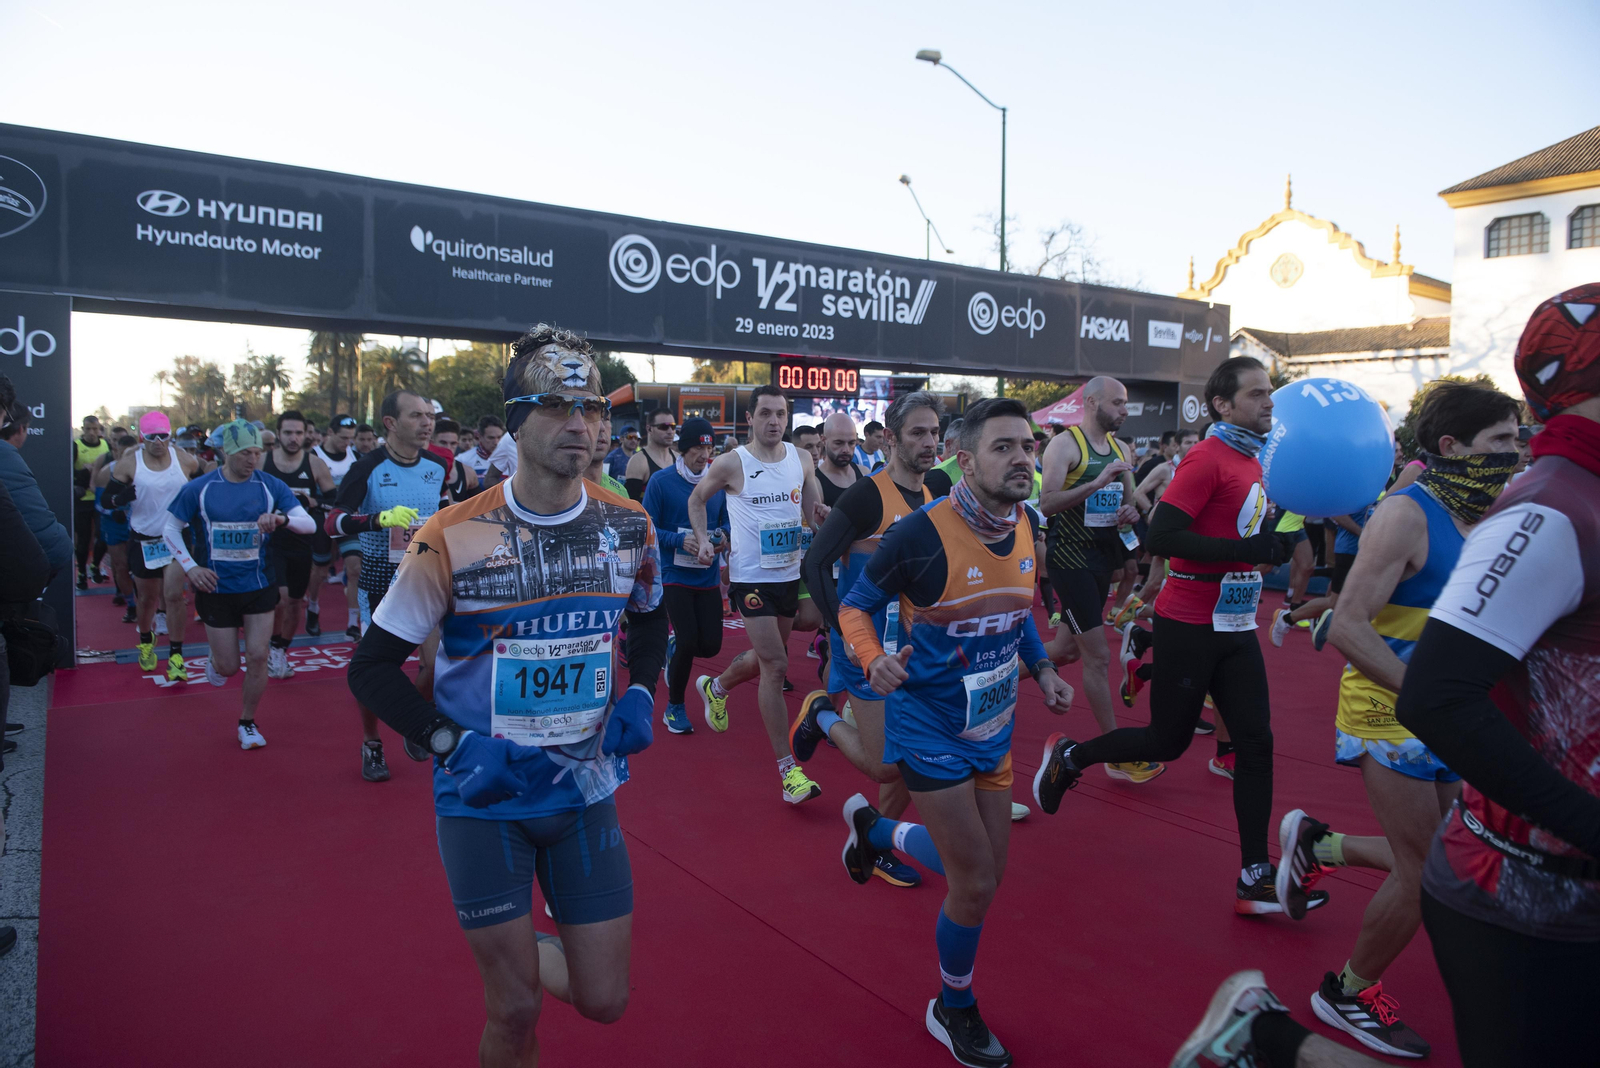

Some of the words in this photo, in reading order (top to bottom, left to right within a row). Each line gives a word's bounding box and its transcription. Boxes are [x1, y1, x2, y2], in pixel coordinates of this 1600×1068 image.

[198, 199, 323, 232] HYUNDAI
[136, 223, 257, 254] Hyundauto
[262, 237, 322, 260] Motor
[452, 266, 511, 284] Healthcare
[514, 273, 553, 289] Partner
[665, 244, 741, 300] edp
[789, 261, 911, 299] maratón
[821, 292, 911, 325] sevilla
[1000, 297, 1046, 339] edp
[735, 317, 754, 333] 29
[756, 322, 799, 338] enero
[801, 323, 835, 341] 2023
[1079, 315, 1131, 342] HOKA
[0, 315, 57, 367] dp
[1273, 422, 1288, 443] FLY
[752, 491, 790, 505] amiab
[1093, 493, 1118, 507] 1526
[220, 532, 250, 545] 1107
[768, 530, 796, 547] 1217
[801, 534, 814, 545] 84
[148, 543, 170, 556] 214
[1461, 511, 1545, 618] LOBOS
[1225, 586, 1254, 605] 3399
[288, 646, 354, 657] dp
[523, 644, 546, 658] edp
[559, 639, 594, 650] maratón
[567, 645, 594, 656] sevilla
[975, 650, 996, 664] Los
[974, 659, 1001, 671] centro
[514, 662, 586, 699] 1947
[977, 678, 1011, 715] 2909
[553, 715, 573, 725] edp
[599, 825, 625, 852] iD
[471, 902, 517, 918] LURBEL
